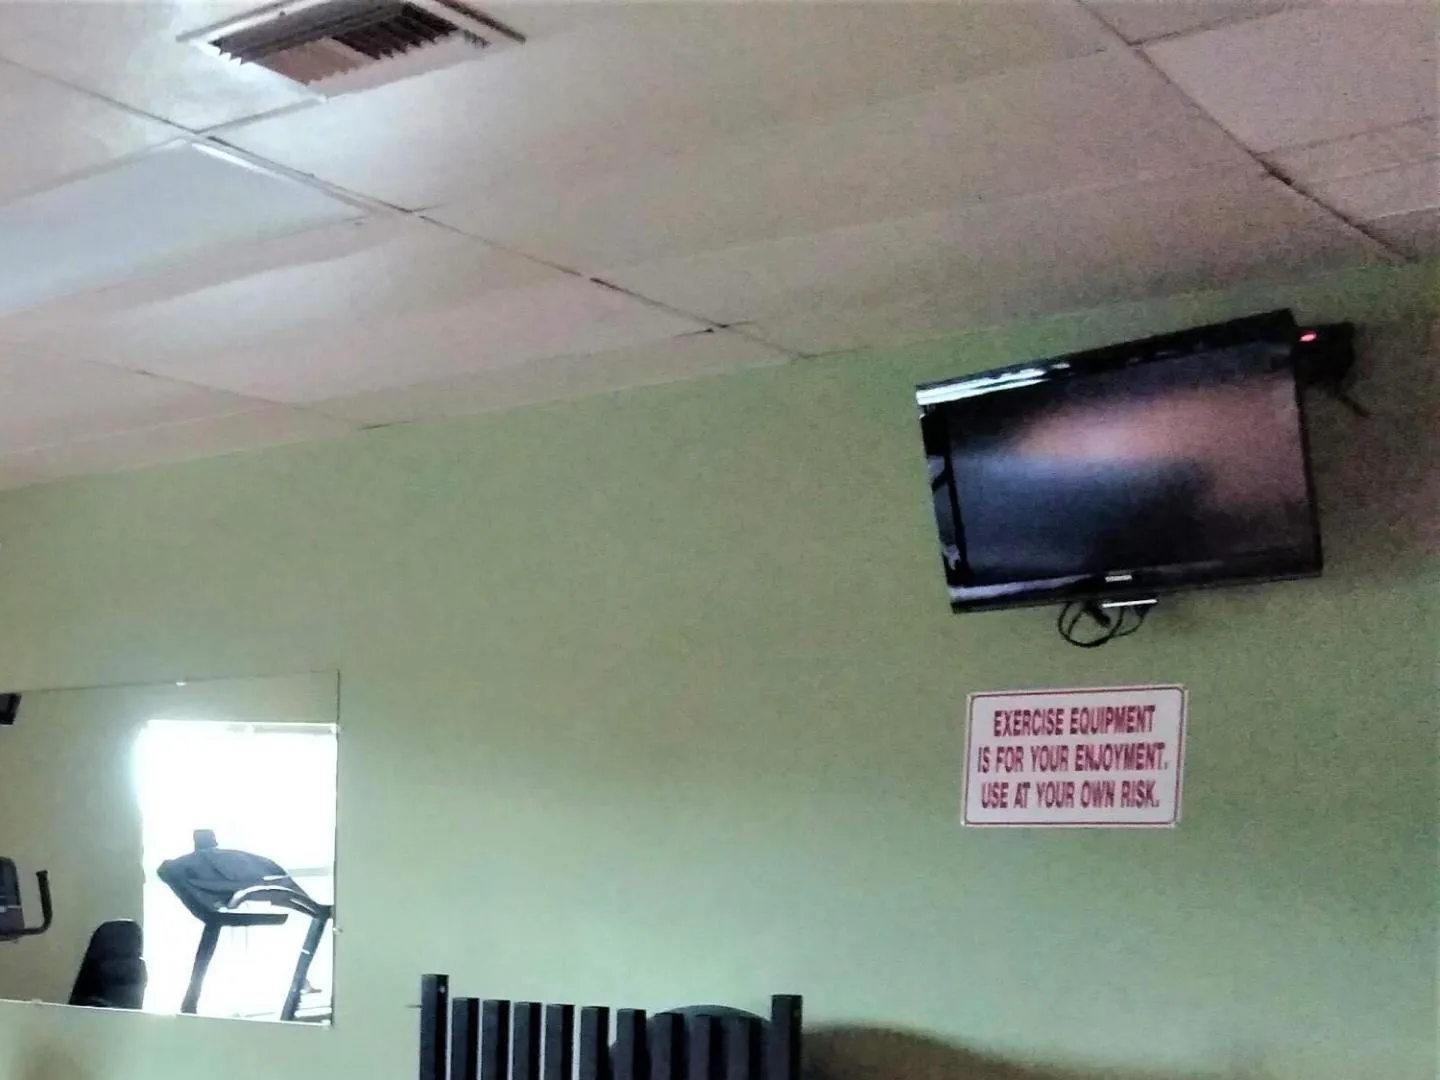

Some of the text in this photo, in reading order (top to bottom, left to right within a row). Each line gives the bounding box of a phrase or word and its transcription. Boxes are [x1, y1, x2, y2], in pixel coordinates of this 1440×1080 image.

[994, 705, 1155, 737] EXERCISE EQUIPMENT
[977, 742, 1168, 773] IS FOR YOUR ENJOYMENT.
[981, 780, 1159, 809] USE AT YOUR OWN RISK.
